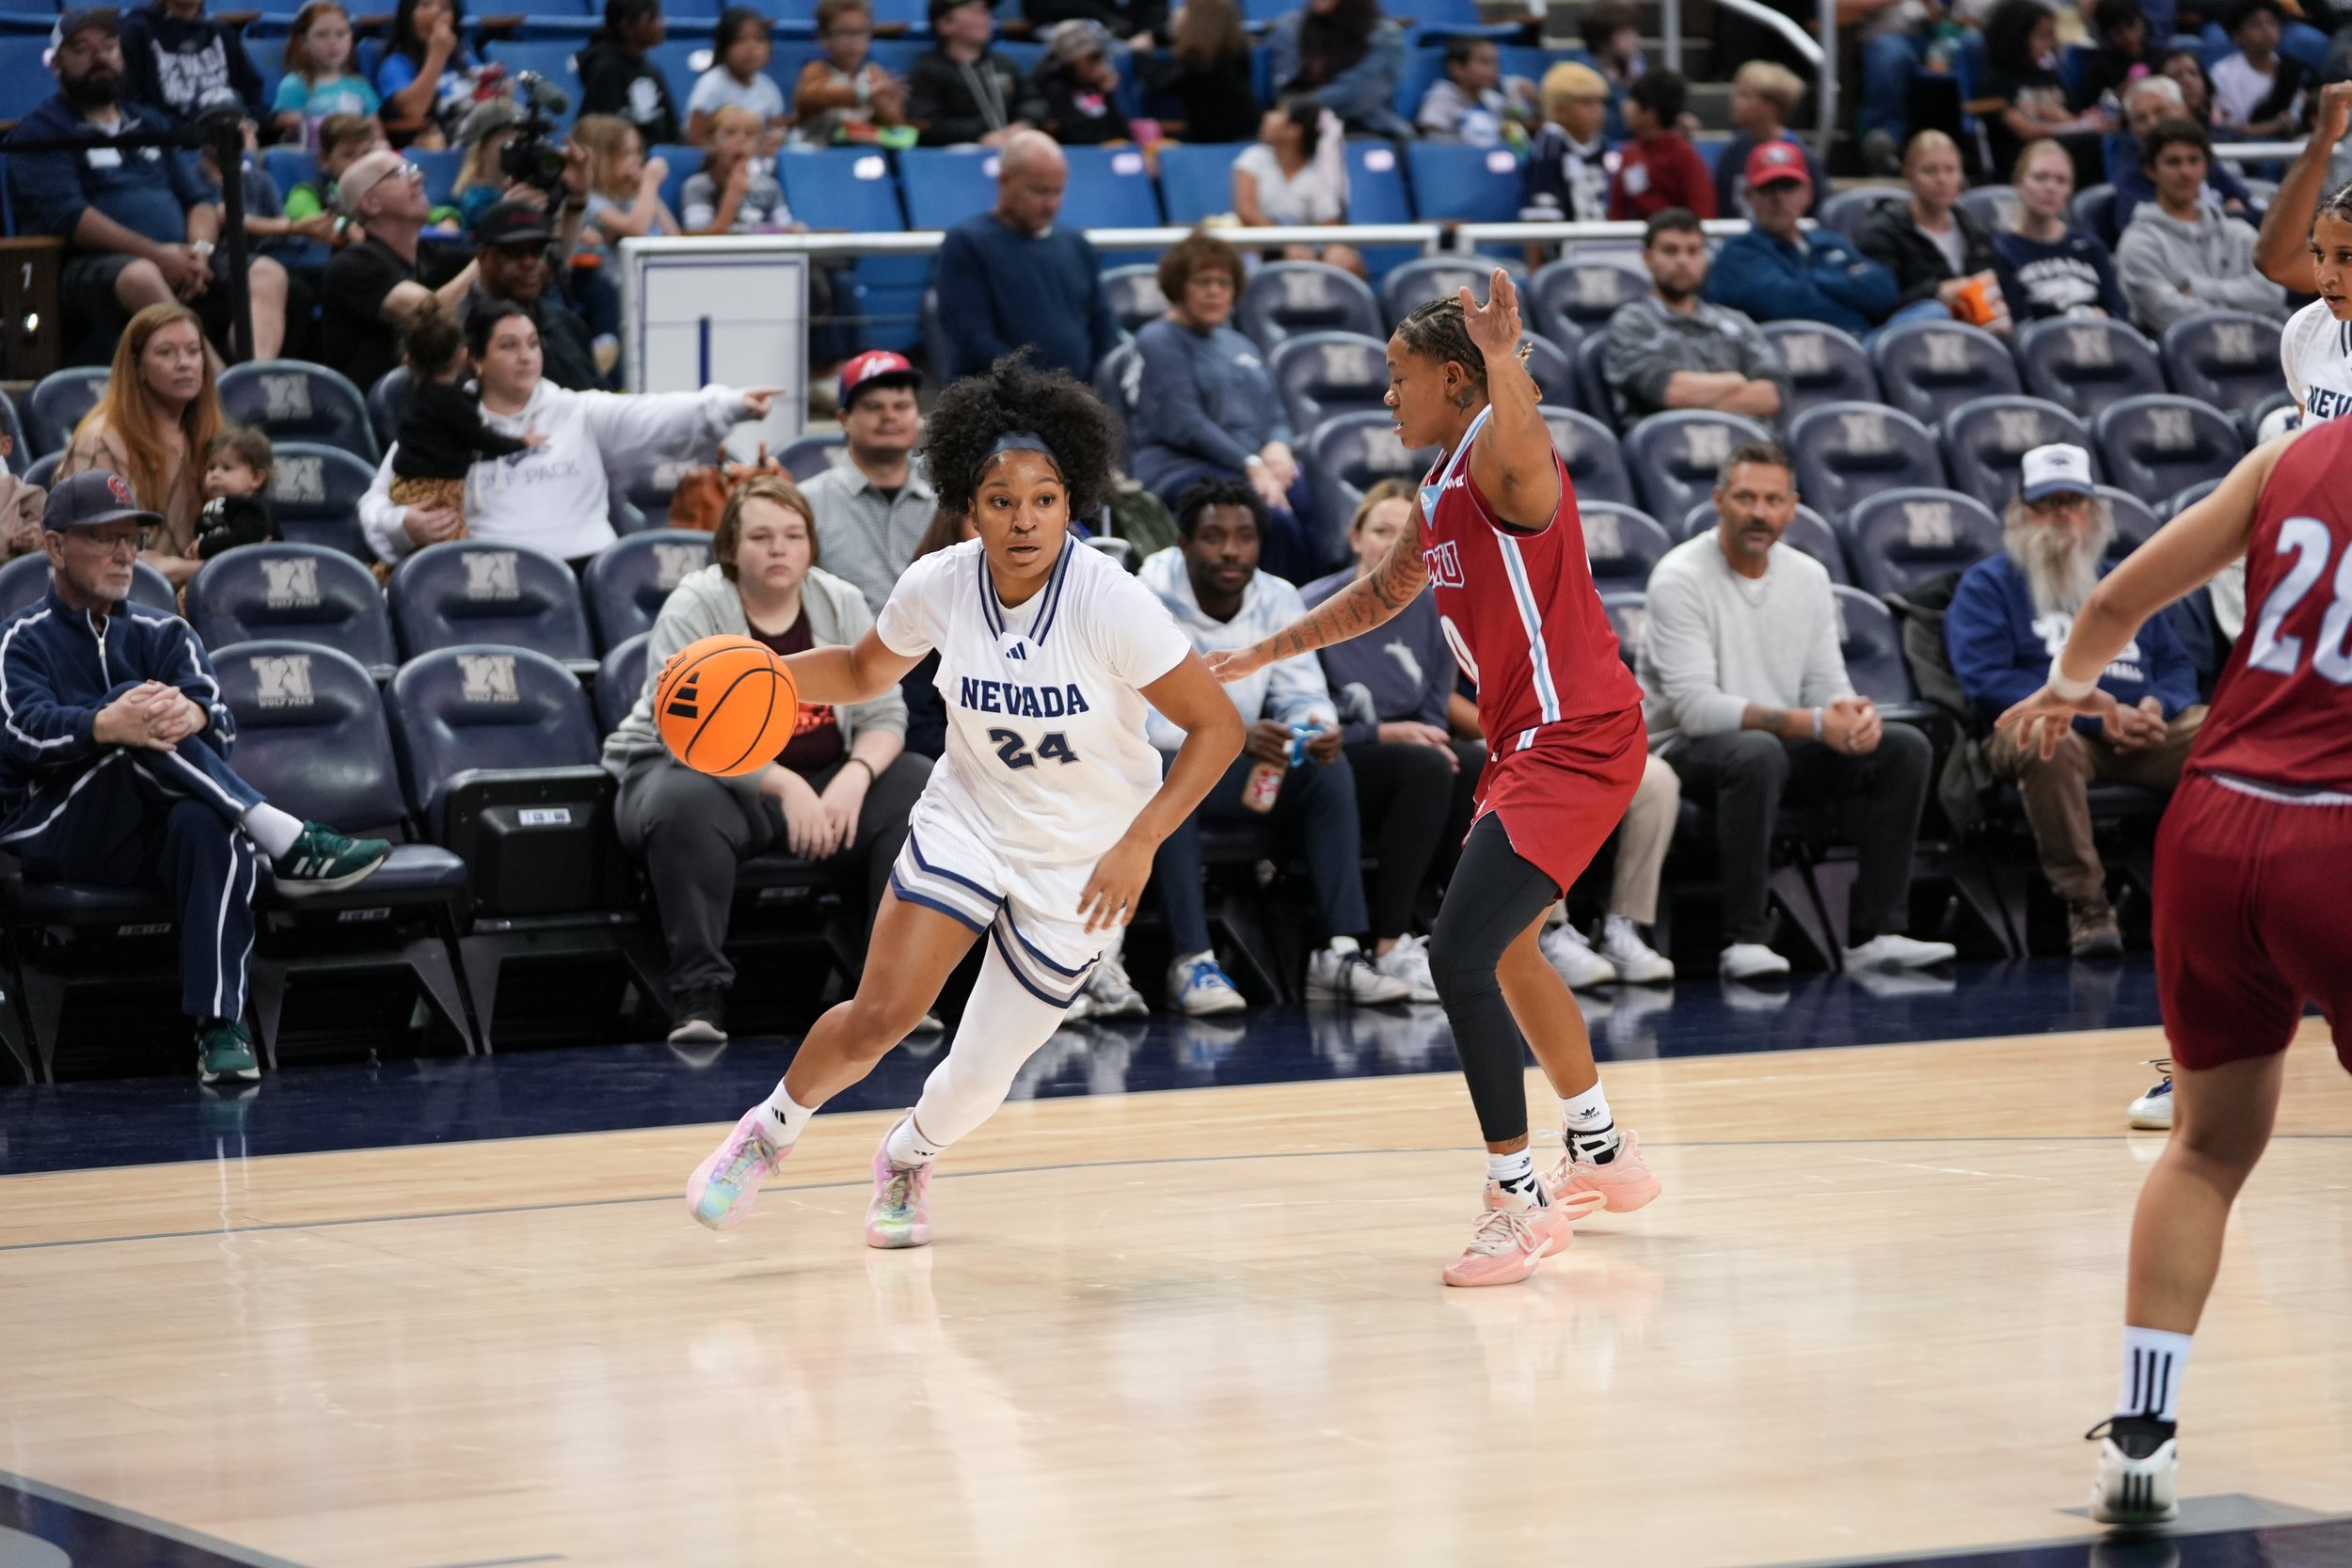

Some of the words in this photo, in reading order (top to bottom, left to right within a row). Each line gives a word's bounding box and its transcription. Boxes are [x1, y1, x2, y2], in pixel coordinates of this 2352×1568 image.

[259, 697, 287, 710] WOLF
[288, 696, 315, 708] PACK
[961, 676, 1090, 718] NEVADA
[986, 726, 1082, 771] 24
